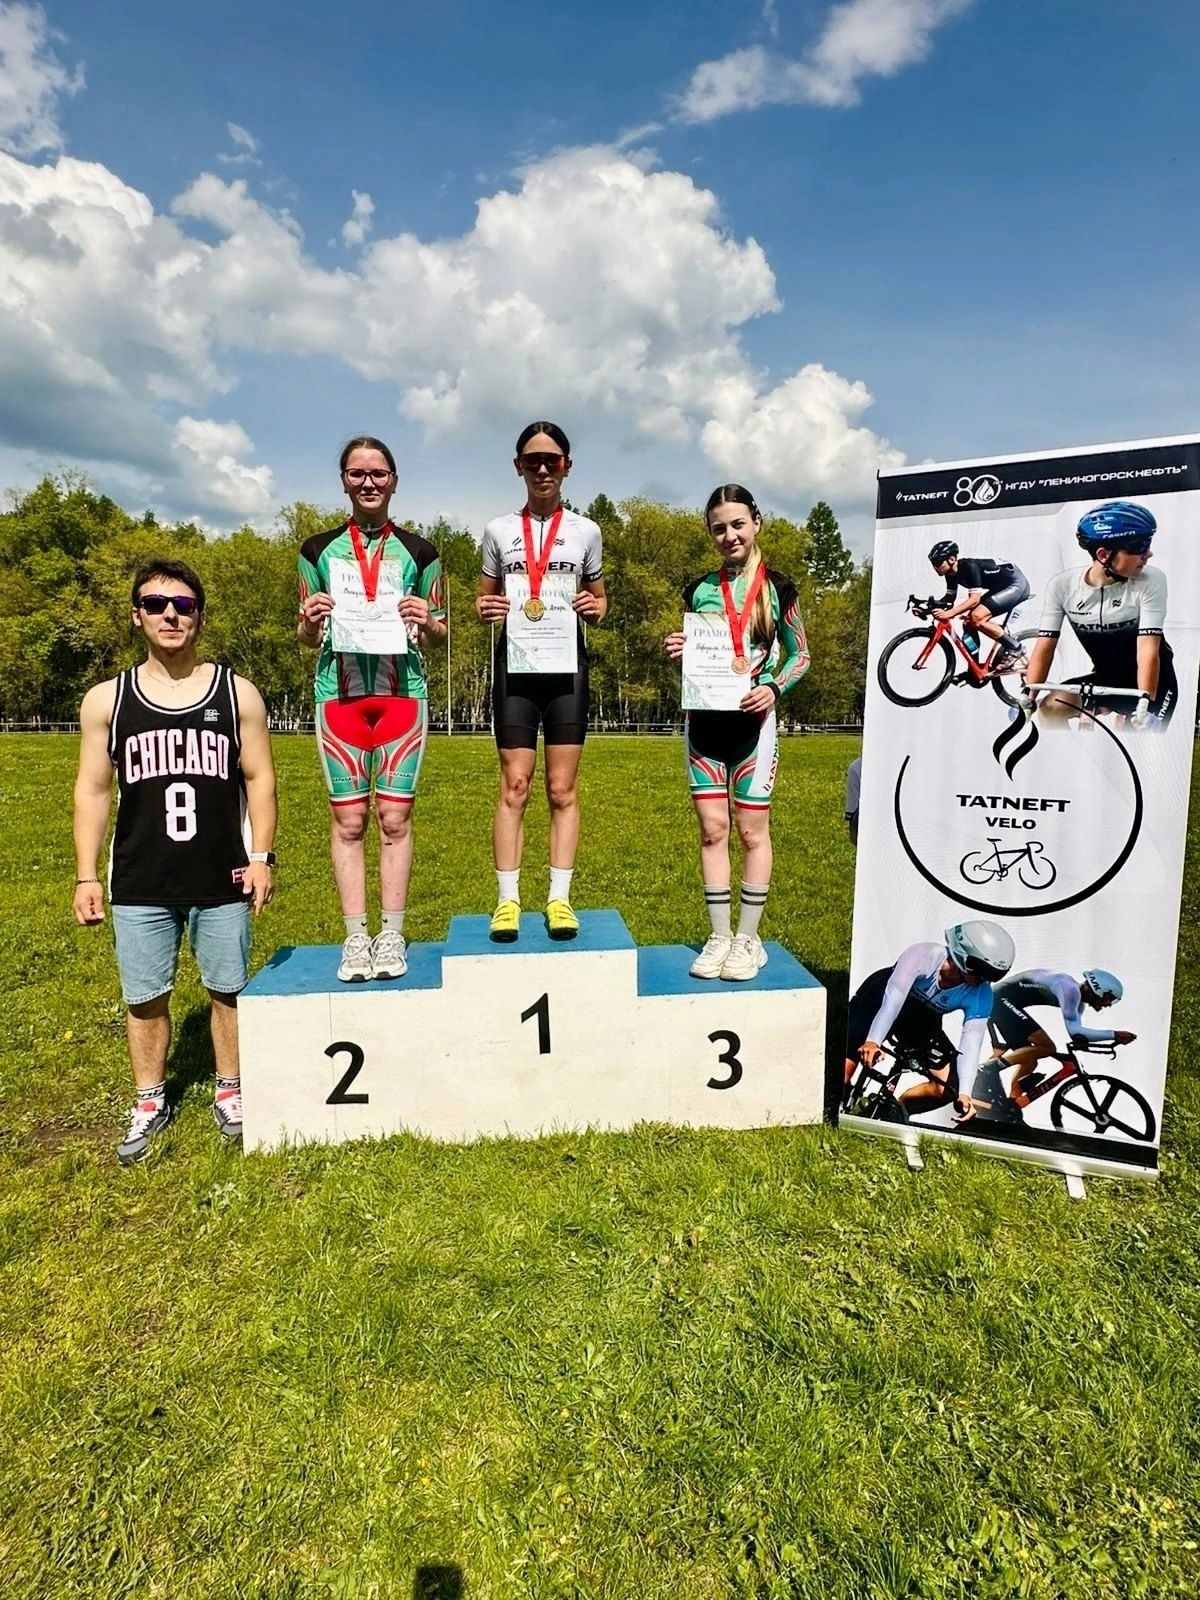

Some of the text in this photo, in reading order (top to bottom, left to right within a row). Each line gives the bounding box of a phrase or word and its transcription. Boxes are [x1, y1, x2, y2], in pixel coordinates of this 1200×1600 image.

[902, 491, 949, 502] TATNEFT
[1005, 480, 1036, 490] НГДУ
[1038, 465, 1188, 487] "ЛЕНИНОГОРСКНЕФТЬ"
[503, 561, 576, 574] TATEFT
[125, 728, 230, 785] CHICAGO
[165, 782, 198, 842] 8
[956, 794, 1071, 813] TATNEFT
[985, 816, 1037, 830] VELO
[520, 992, 552, 1055] 1
[324, 1041, 370, 1105] 2
[706, 1029, 743, 1090] 3
